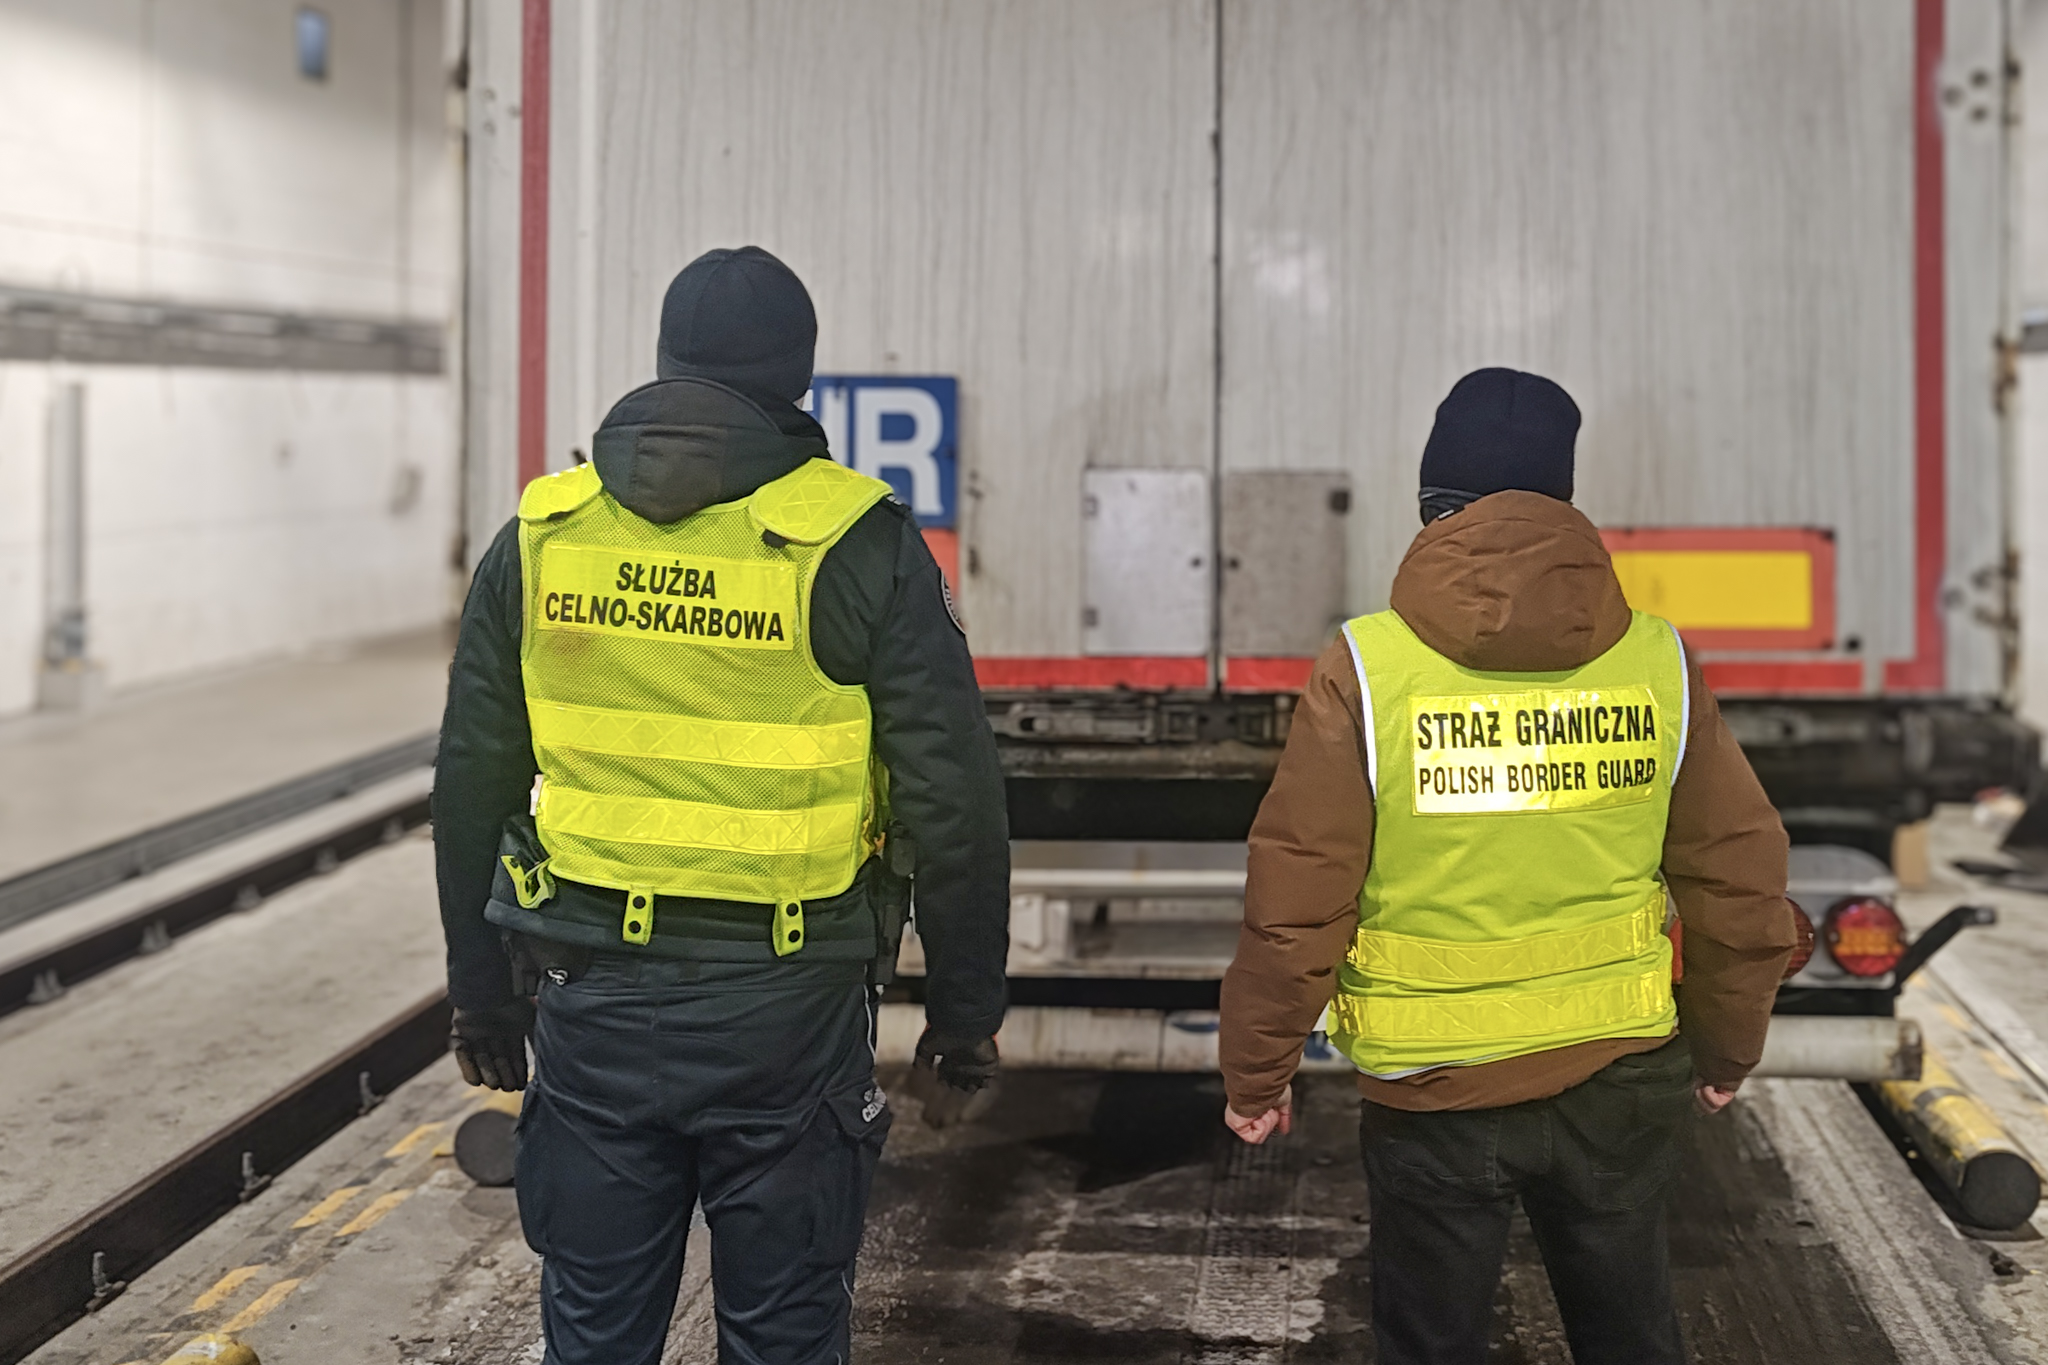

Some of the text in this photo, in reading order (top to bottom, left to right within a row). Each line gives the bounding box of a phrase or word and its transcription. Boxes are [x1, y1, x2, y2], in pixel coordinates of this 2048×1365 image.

[793, 386, 943, 515] IR
[616, 560, 716, 599] SŁUŻBA
[545, 592, 784, 641] CELNO-SKARBOWA
[1515, 705, 1656, 746] GRANICZNA
[1419, 757, 1656, 795] POLISH BORDER GUARD
